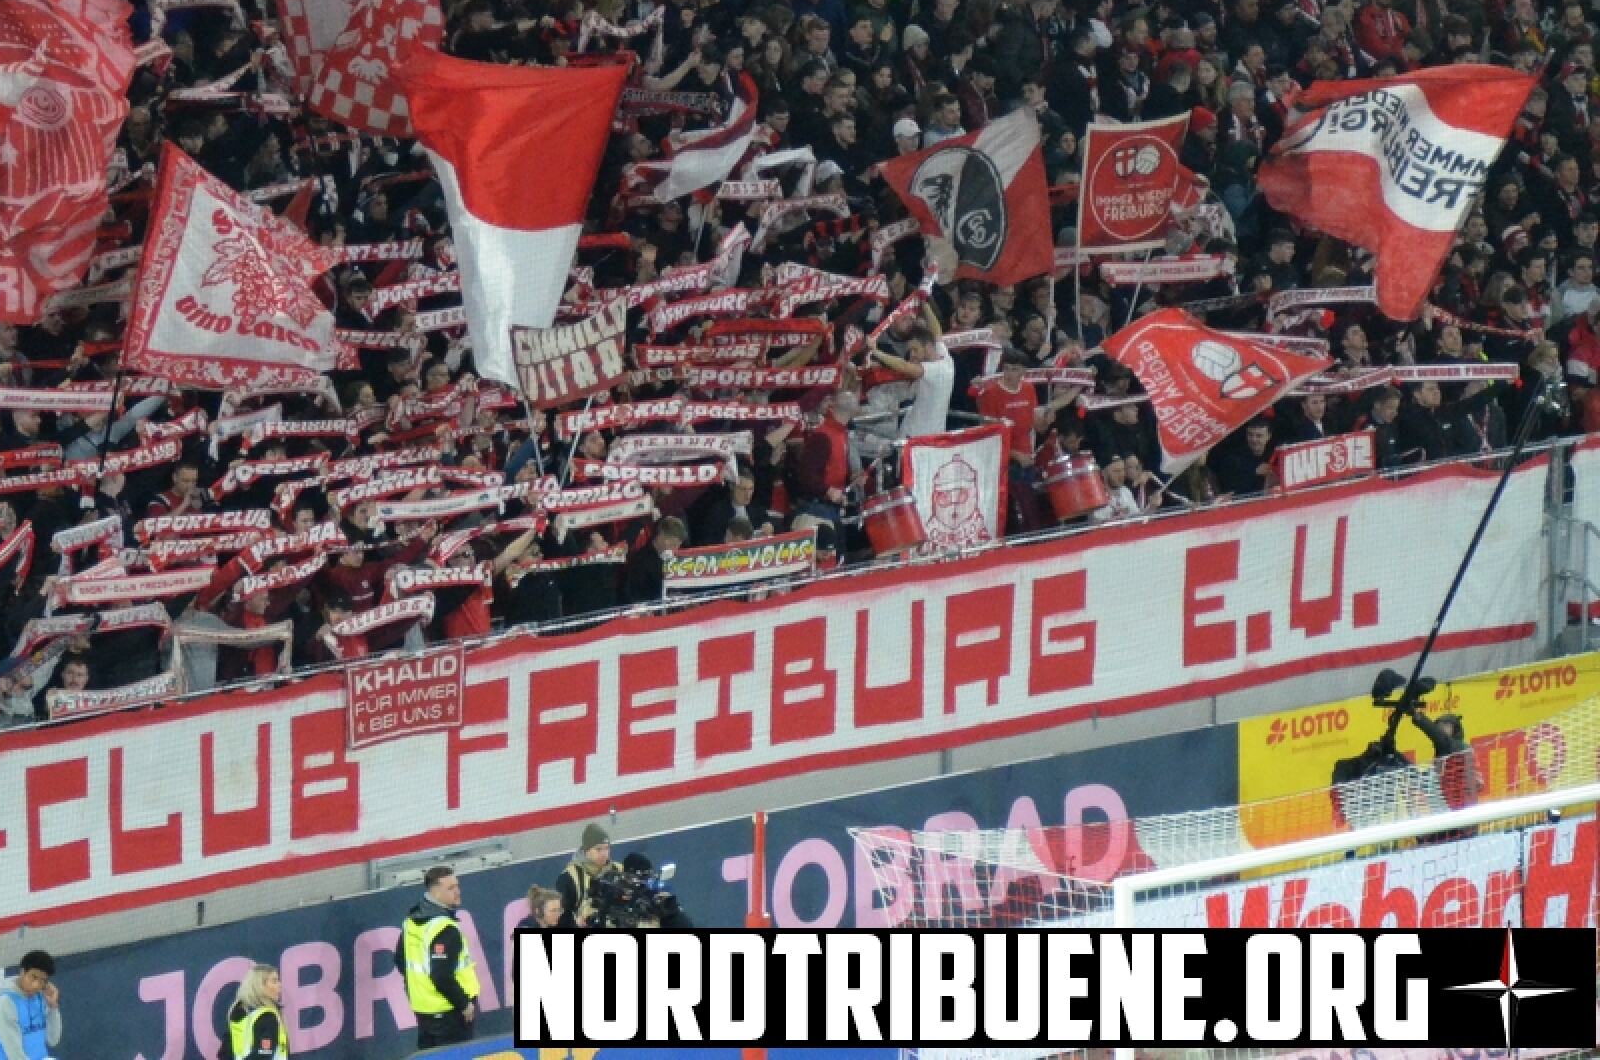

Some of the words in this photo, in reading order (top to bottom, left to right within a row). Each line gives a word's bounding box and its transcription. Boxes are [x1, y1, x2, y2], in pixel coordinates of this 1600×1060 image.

[355, 654, 458, 696] KHALID
[447, 569, 1097, 809] FREIBURG
[1519, 665, 1578, 695] LOTTO
[355, 694, 393, 717] FÜR
[397, 682, 458, 707] IMMER
[369, 711, 399, 734] BEI
[403, 703, 443, 725] UNS
[1291, 708, 1350, 739] LOTTO
